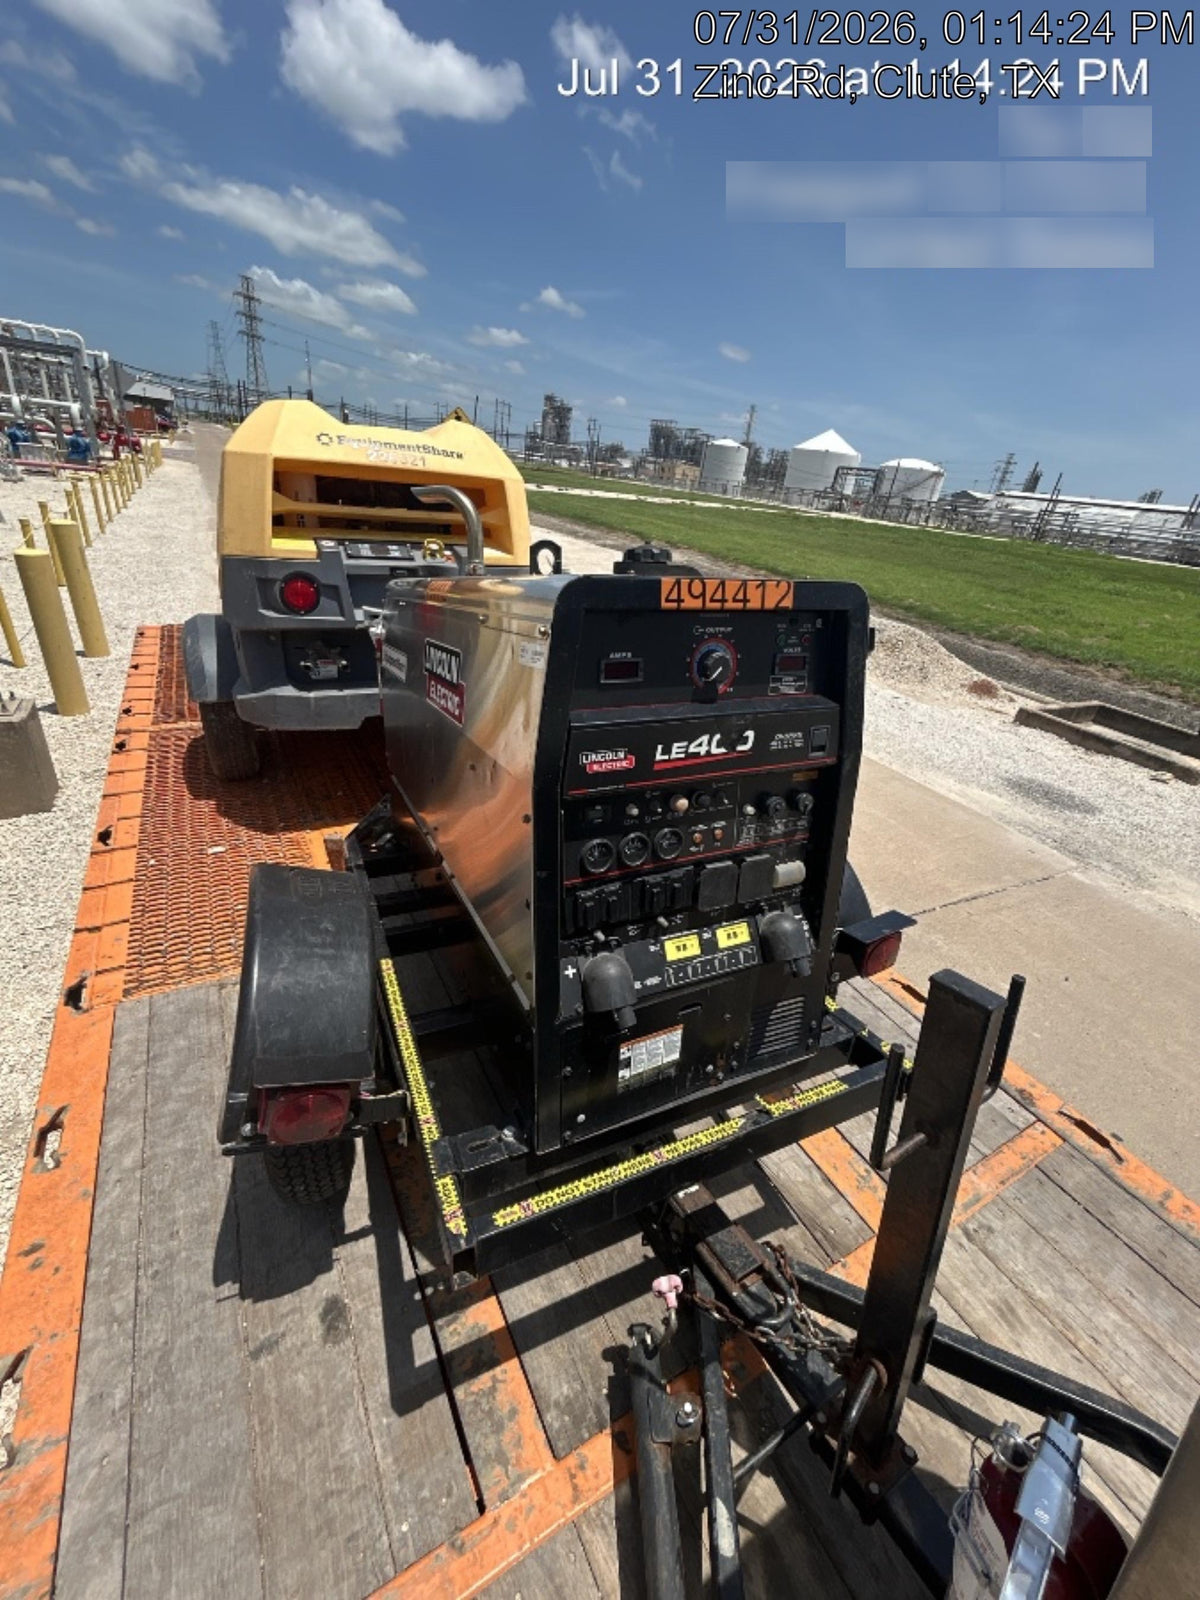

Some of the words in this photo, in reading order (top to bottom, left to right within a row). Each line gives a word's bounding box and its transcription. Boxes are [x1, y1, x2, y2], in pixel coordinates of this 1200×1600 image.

[664, 577, 793, 611] 494412
[609, 651, 632, 659] AMPS
[582, 751, 625, 764] LINCOLN
[556, 1182, 582, 1201] NOT
